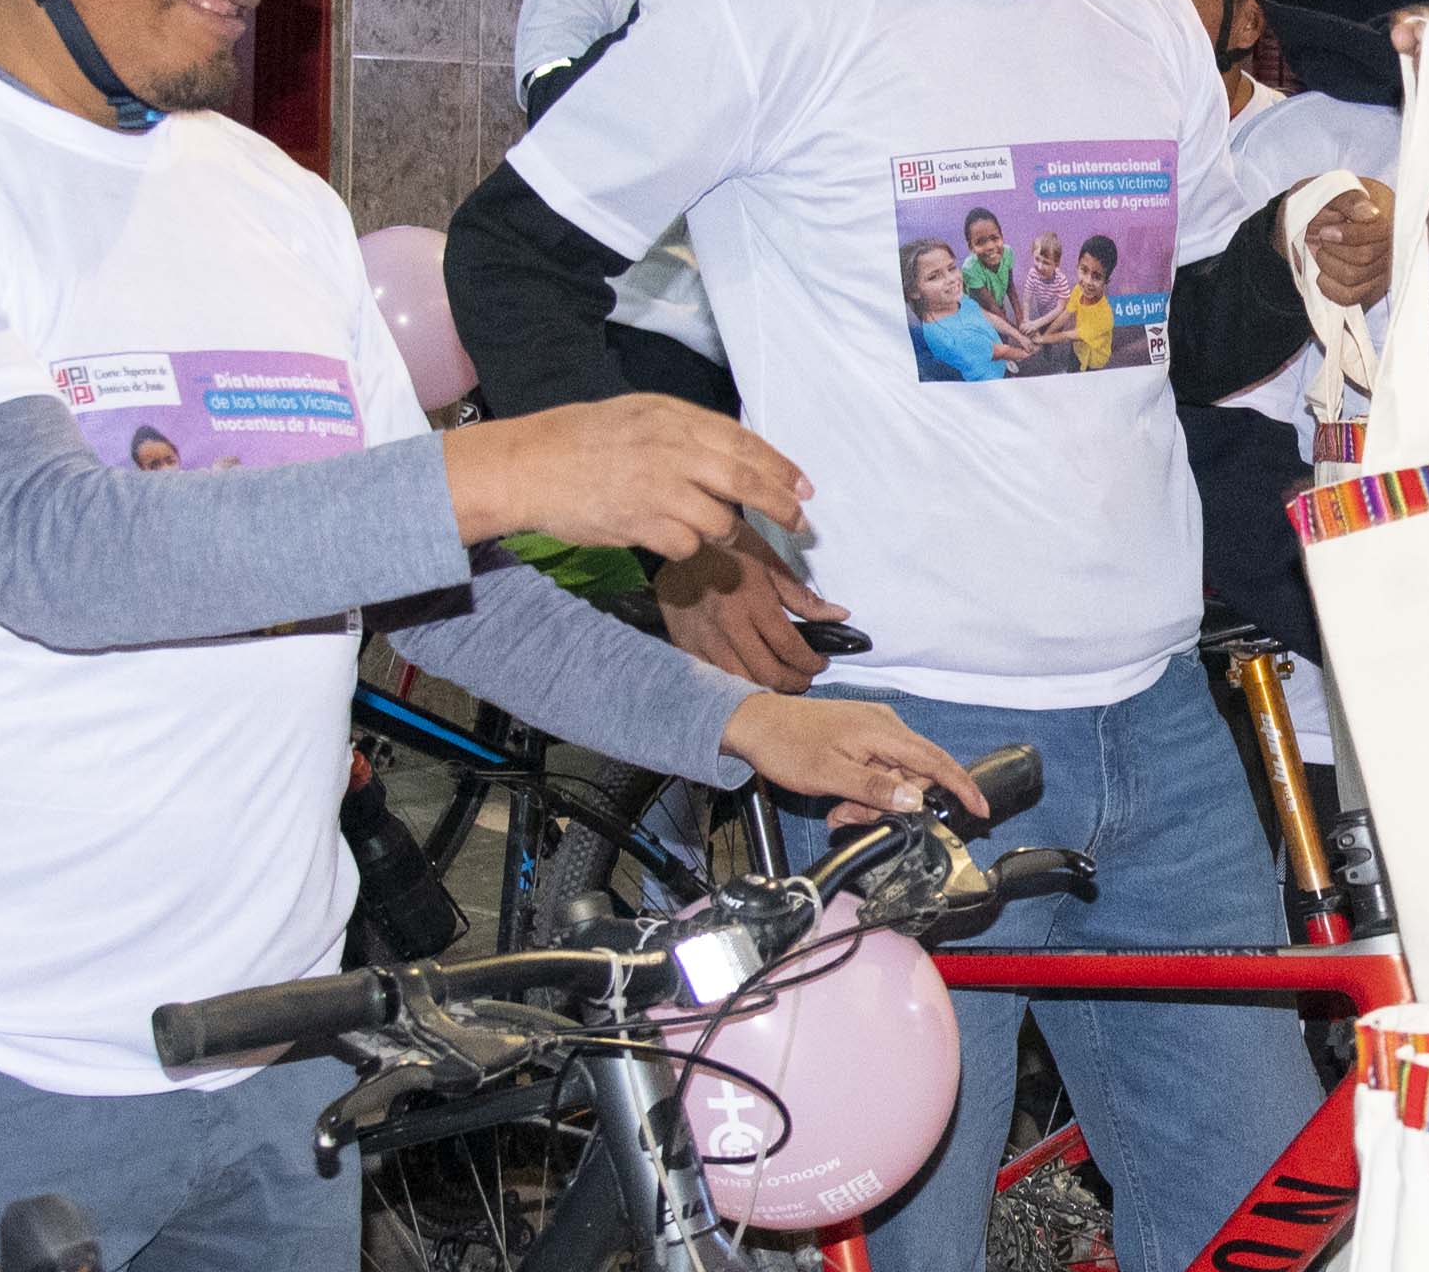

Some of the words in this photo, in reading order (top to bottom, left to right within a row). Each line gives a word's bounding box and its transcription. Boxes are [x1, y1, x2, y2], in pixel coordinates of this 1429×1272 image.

[938, 160, 962, 171] Corte
[964, 159, 997, 171] Superior
[1073, 158, 1160, 173] Internacional
[1040, 181, 1056, 193] de
[1059, 179, 1077, 193] los
[1037, 197, 1101, 213] Inocentes
[1103, 197, 1118, 210] de
[1115, 303, 1123, 315] 4
[1125, 301, 1141, 314] de
[1141, 298, 1165, 318] juni
[239, 374, 341, 393] Internacional
[212, 395, 230, 409] de
[232, 395, 254, 410] los
[212, 417, 285, 433] Inocentes
[287, 418, 305, 433] de
